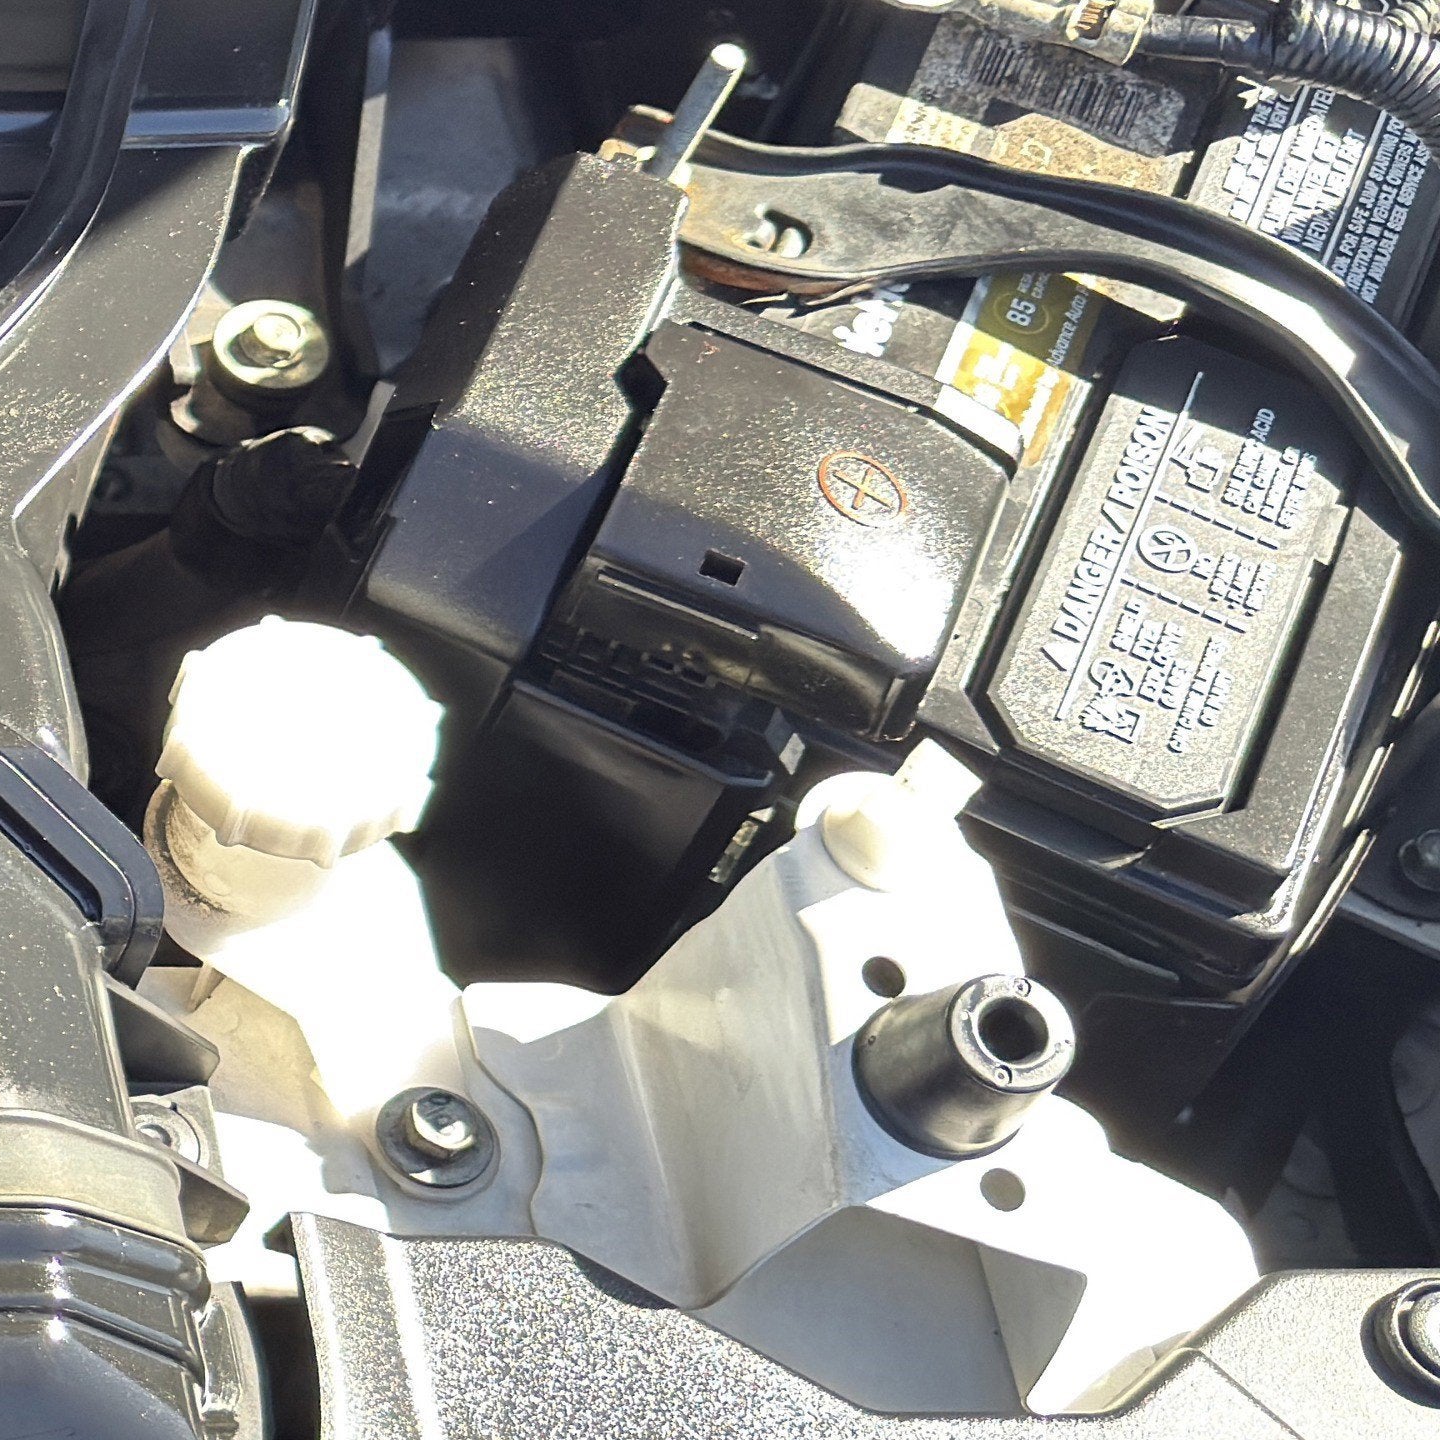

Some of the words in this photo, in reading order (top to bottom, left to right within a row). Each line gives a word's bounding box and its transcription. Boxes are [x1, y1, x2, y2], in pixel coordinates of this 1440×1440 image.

[1250, 101, 1272, 127] THE
[1266, 99, 1292, 131] VENT
[1366, 132, 1402, 182] STARTING
[1383, 142, 1415, 187] OWNERS
[1356, 178, 1382, 209] JUMP
[1394, 162, 1427, 206] SERVICE
[1346, 205, 1370, 234] SAFE
[1368, 183, 1399, 226] VEHICLE
[1384, 202, 1410, 232] SEEK
[1338, 231, 1360, 256] FOR
[1365, 220, 1383, 239] IN
[1340, 235, 1381, 294] TRUCTIONS
[1364, 229, 1401, 282] AVAILABLE
[1004, 295, 1037, 328] 85
[1063, 293, 1087, 322] Auto
[1247, 404, 1278, 442] ACID
